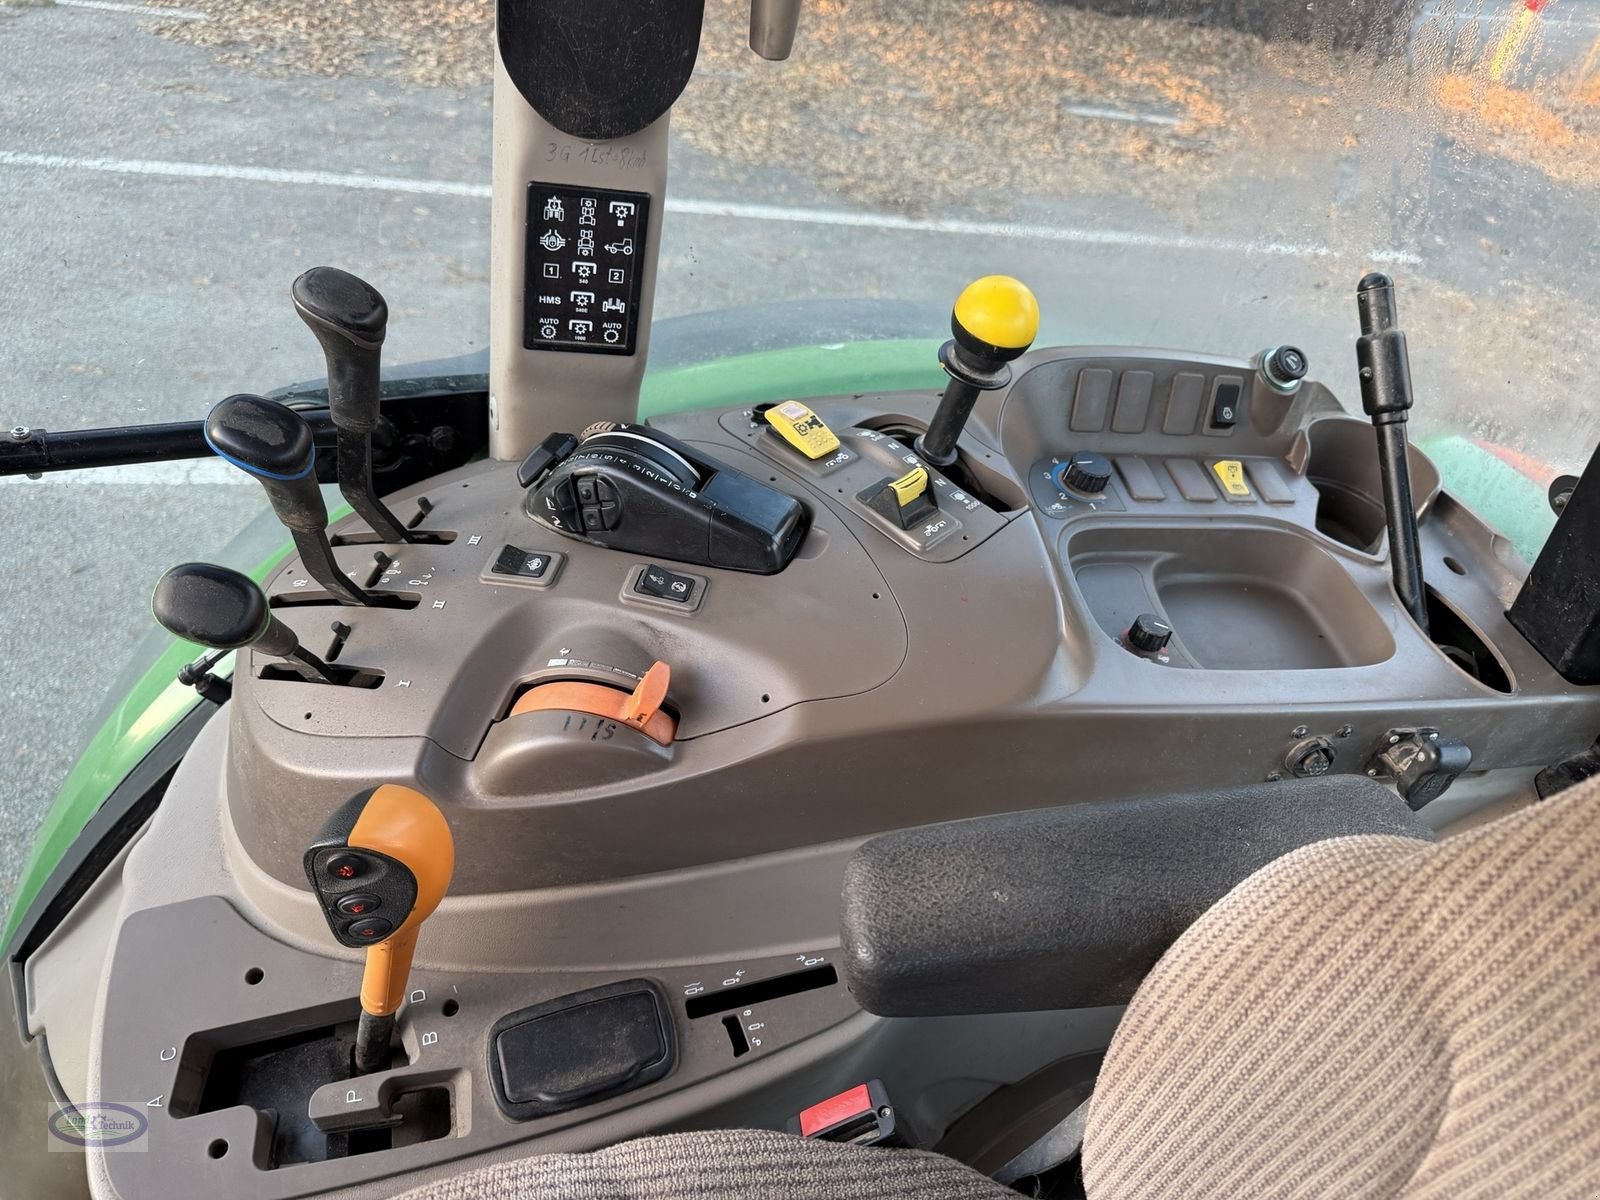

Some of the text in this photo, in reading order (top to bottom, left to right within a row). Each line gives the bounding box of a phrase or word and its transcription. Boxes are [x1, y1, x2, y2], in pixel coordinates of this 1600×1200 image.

[539, 296, 561, 304] HMS
[410, 988, 427, 1004] D
[422, 1030, 439, 1046] B
[160, 1046, 176, 1062] C
[147, 1094, 162, 1108] A
[346, 1090, 362, 1103] P
